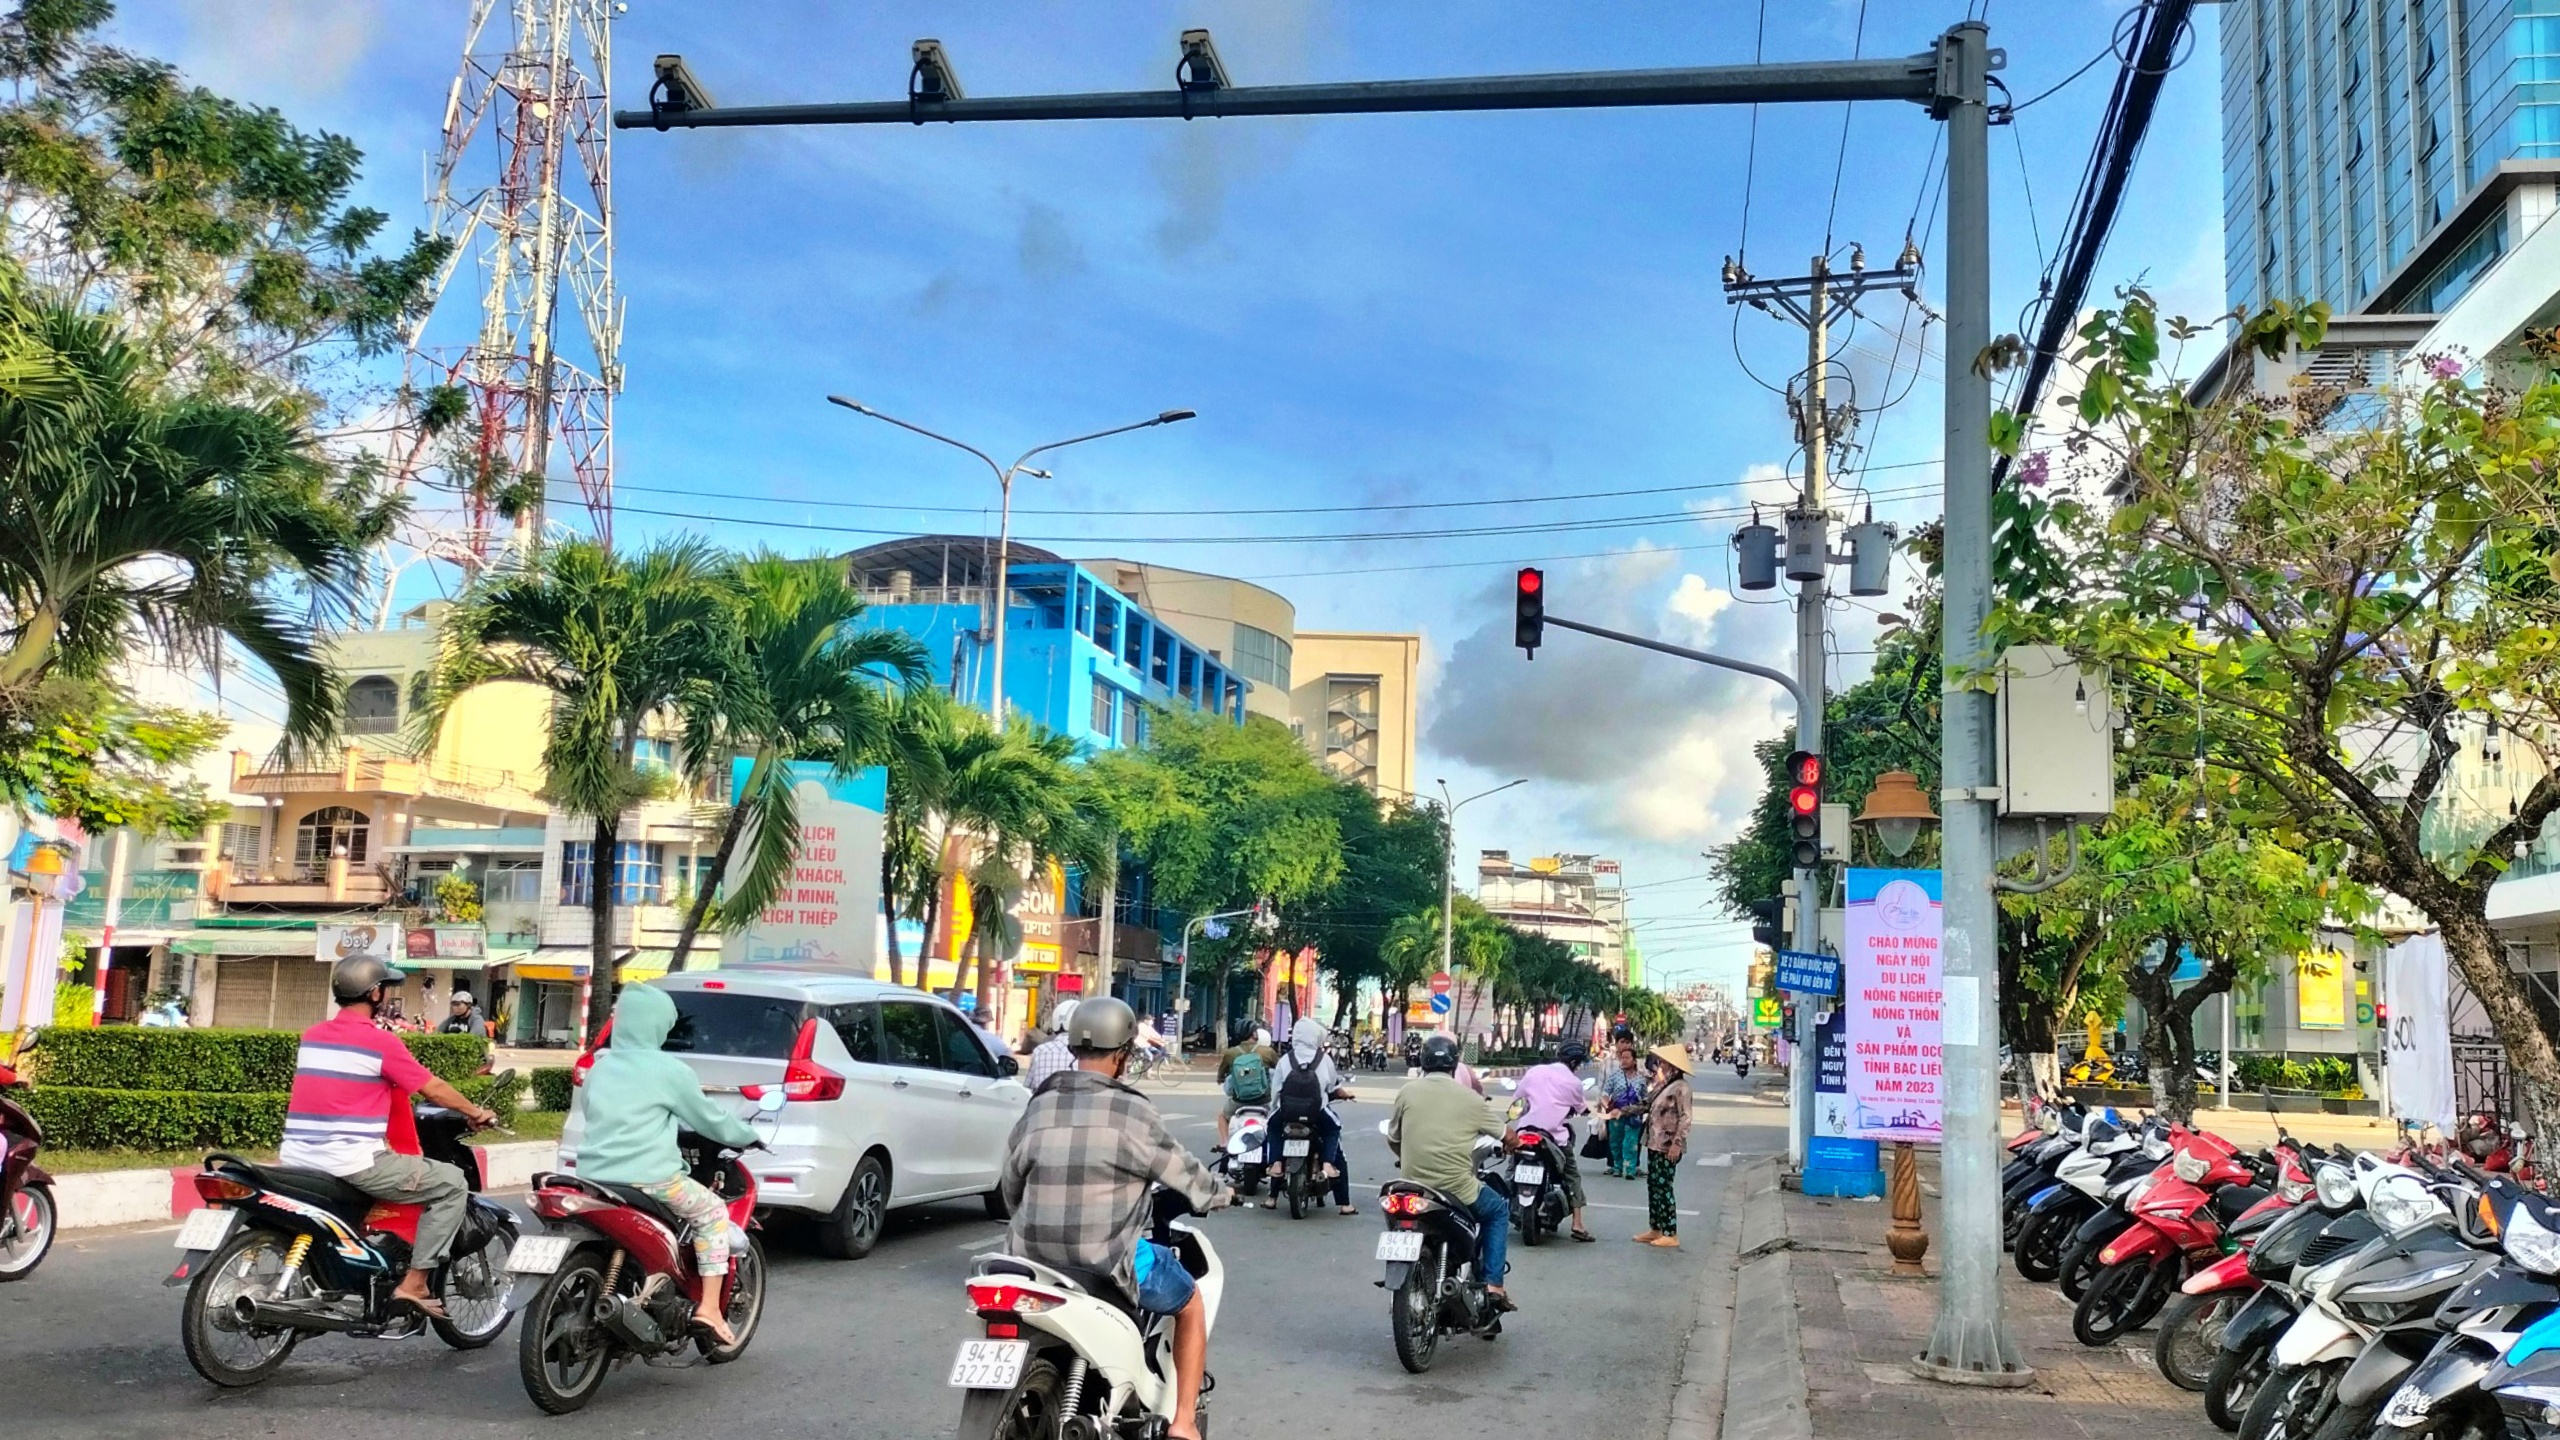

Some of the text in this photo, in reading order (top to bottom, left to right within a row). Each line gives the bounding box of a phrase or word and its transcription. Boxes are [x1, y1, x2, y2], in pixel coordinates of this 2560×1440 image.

[804, 826, 836, 843] LỊCH
[806, 845, 836, 862] LIÊU
[796, 866, 846, 884] KHÁCH,
[762, 908, 838, 928] LỊCH THIỆP
[1868, 934, 1899, 949] CHÀO
[1876, 952, 1930, 970] NGÀY HỘI
[1881, 972, 1926, 987] DU LỊCH
[1864, 987, 1942, 1006] NÔNG NGHIỆP
[1872, 1005, 1939, 1021] NÔNG THÔN
[1896, 1024, 1912, 1038] VÀ
[1856, 1040, 1880, 1055] SẢN
[1883, 1040, 1918, 1057] PHẨM
[1821, 1061, 1845, 1071] NGUY
[1863, 1057, 1890, 1073] TỈNH
[1893, 1062, 1917, 1077] BẠC
[1875, 1078, 1934, 1093] NĂM 2023
[1386, 1233, 1414, 1246] 94-K1
[1380, 1246, 1416, 1259] 094.18
[508, 1254, 558, 1272] 212.72
[967, 1343, 1016, 1363] 94-K2
[954, 1364, 1016, 1385] 327.93
